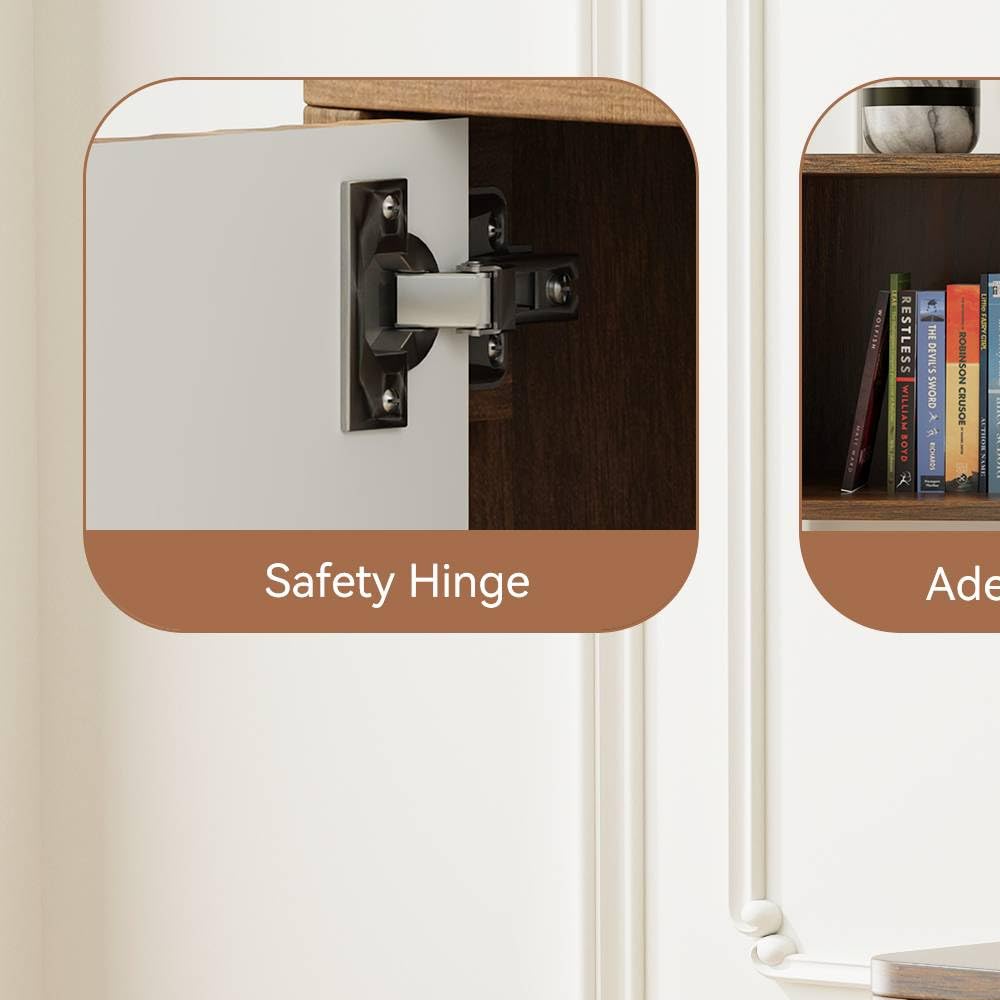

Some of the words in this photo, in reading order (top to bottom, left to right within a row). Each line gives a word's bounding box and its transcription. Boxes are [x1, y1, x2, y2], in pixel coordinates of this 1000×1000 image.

[900, 296, 912, 374] RESTLESS
[928, 324, 937, 340] THE
[928, 342, 937, 374] DEVIL'S
[958, 331, 967, 384] ROBINSON
[901, 385, 910, 430] WILLIAM
[928, 377, 937, 409] SWORD
[958, 387, 967, 426] CRUSOE
[900, 434, 910, 463] BOYD
